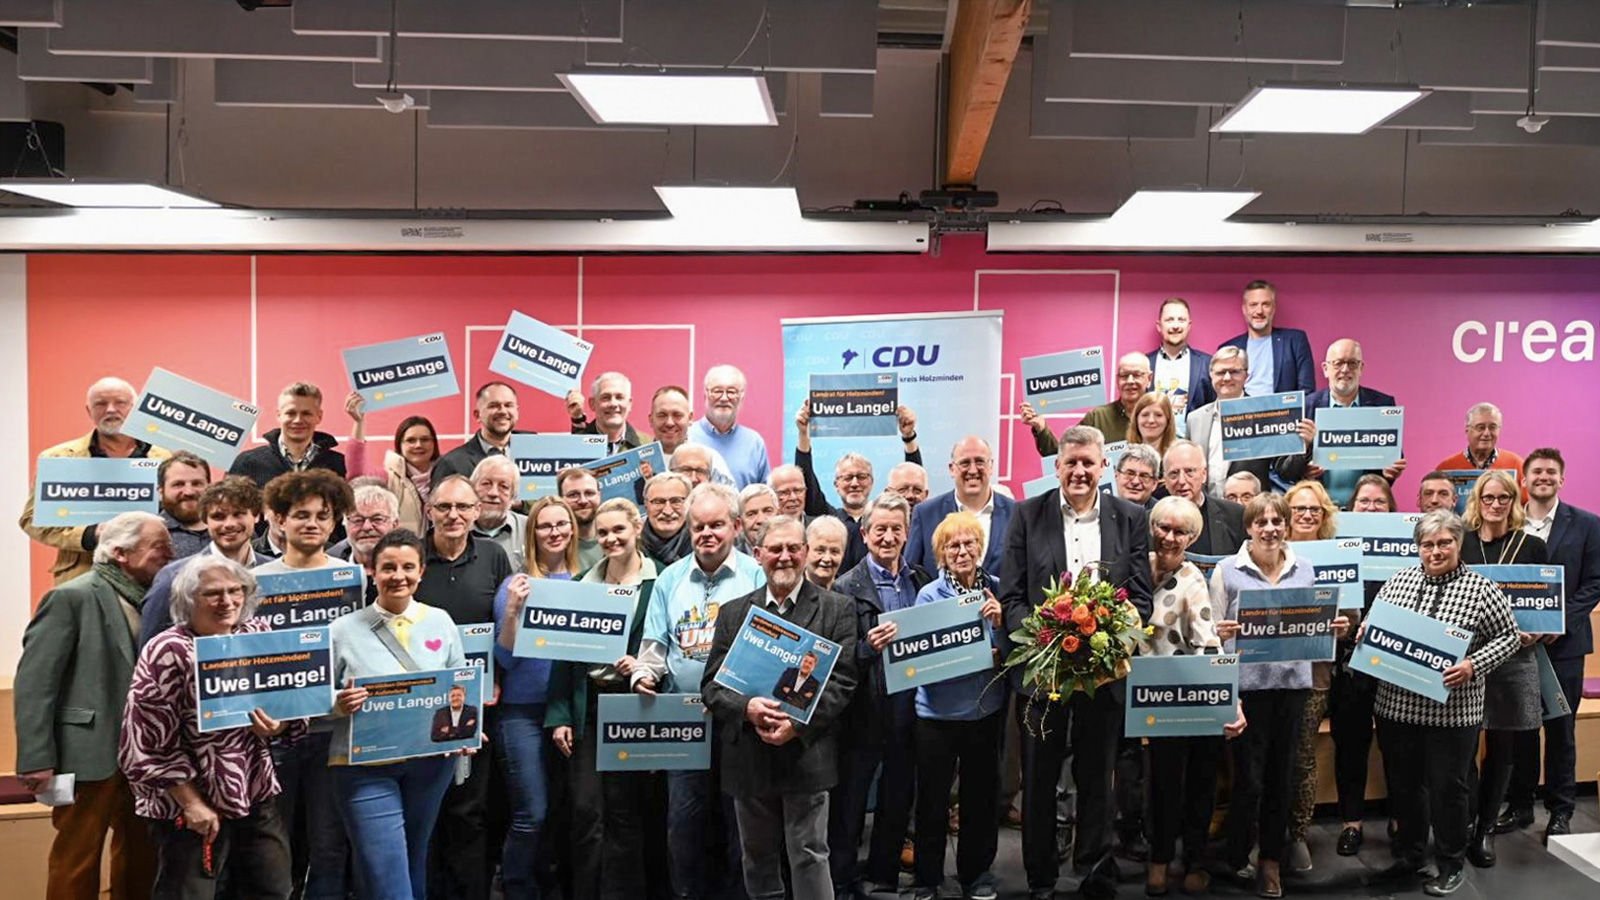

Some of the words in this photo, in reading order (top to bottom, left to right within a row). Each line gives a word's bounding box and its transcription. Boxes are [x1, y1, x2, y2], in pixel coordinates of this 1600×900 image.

[1452, 320, 1595, 363] crea
[509, 338, 538, 358] Uwe
[538, 350, 577, 375] Lange
[872, 345, 940, 367] CDU
[358, 371, 395, 384] Uwe
[396, 360, 444, 378] Lange
[919, 374, 964, 382] Holzminden
[1030, 379, 1057, 391] Uwe
[1060, 373, 1098, 386] Lange
[813, 402, 844, 414] Uwe
[847, 401, 894, 416] Lange!
[147, 397, 185, 421] Uwe
[187, 414, 239, 442] Lange
[1224, 427, 1252, 438] Uwe
[1256, 420, 1298, 434] Lange!
[1322, 432, 1352, 443] Uwe
[1354, 432, 1395, 445] Lange
[520, 461, 552, 472] Uwe
[604, 468, 640, 487] Lange!
[47, 485, 89, 498] Uwe
[94, 485, 150, 500] Lange
[1374, 540, 1418, 555] Lange
[1315, 569, 1356, 582] ange
[964, 595, 982, 604] CDU
[1508, 594, 1558, 610] Lange!
[290, 602, 357, 623] Lange!
[530, 610, 566, 626] Uwe
[570, 613, 622, 633] Lange
[1240, 622, 1276, 636] Uwe
[1279, 619, 1330, 636] Lange!
[1451, 630, 1468, 640] CDU
[681, 629, 716, 648] UW
[743, 630, 764, 647] Uwe
[764, 640, 802, 665] Lange!
[893, 640, 929, 657] Uwe
[932, 626, 981, 648] Lange
[1370, 629, 1404, 651] Uwe
[1404, 642, 1453, 670] Lange
[202, 661, 238, 670] Landrat
[239, 658, 251, 666] für
[254, 653, 310, 665] Holzminden!
[205, 677, 250, 694] Uwe
[254, 666, 325, 689] Lange!
[362, 701, 394, 713] Uwe
[398, 694, 447, 709] Lange!
[1137, 688, 1173, 702] Uwe
[1178, 687, 1230, 704] Lange
[608, 725, 646, 739] Uwe
[650, 724, 703, 741] Lange
